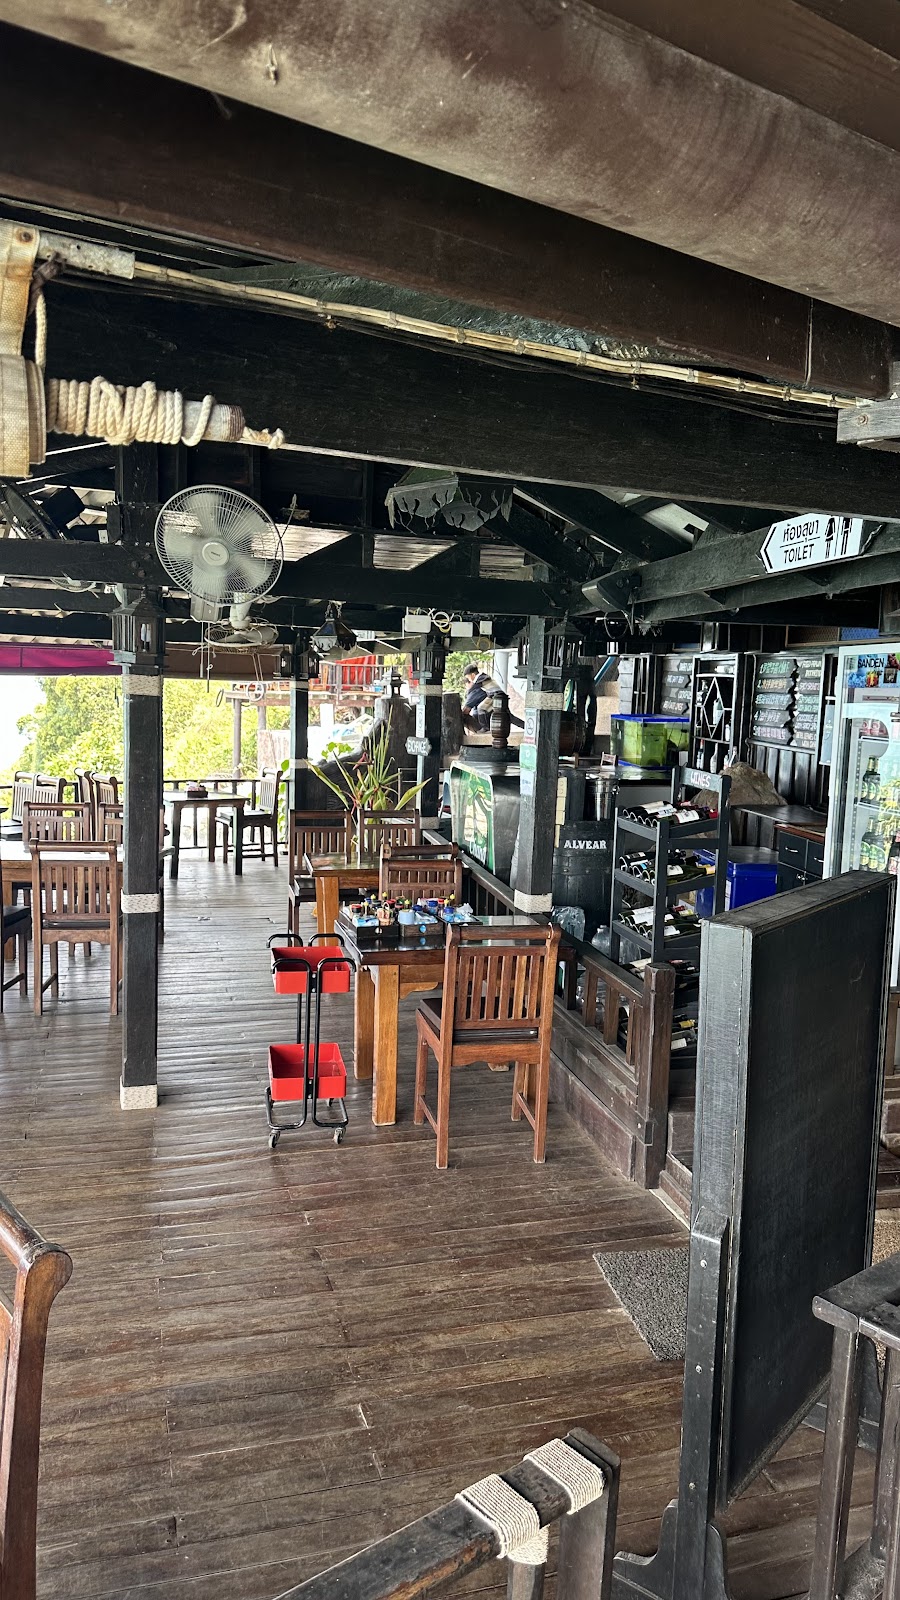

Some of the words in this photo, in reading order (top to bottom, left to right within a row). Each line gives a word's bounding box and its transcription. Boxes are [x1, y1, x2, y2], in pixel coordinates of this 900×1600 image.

[783, 519, 820, 543] ห้องสุขา
[783, 543, 815, 564] TOILET
[857, 657, 885, 669] SANDEN
[690, 770, 711, 788] WINES
[563, 839, 607, 849] ALVEAR
